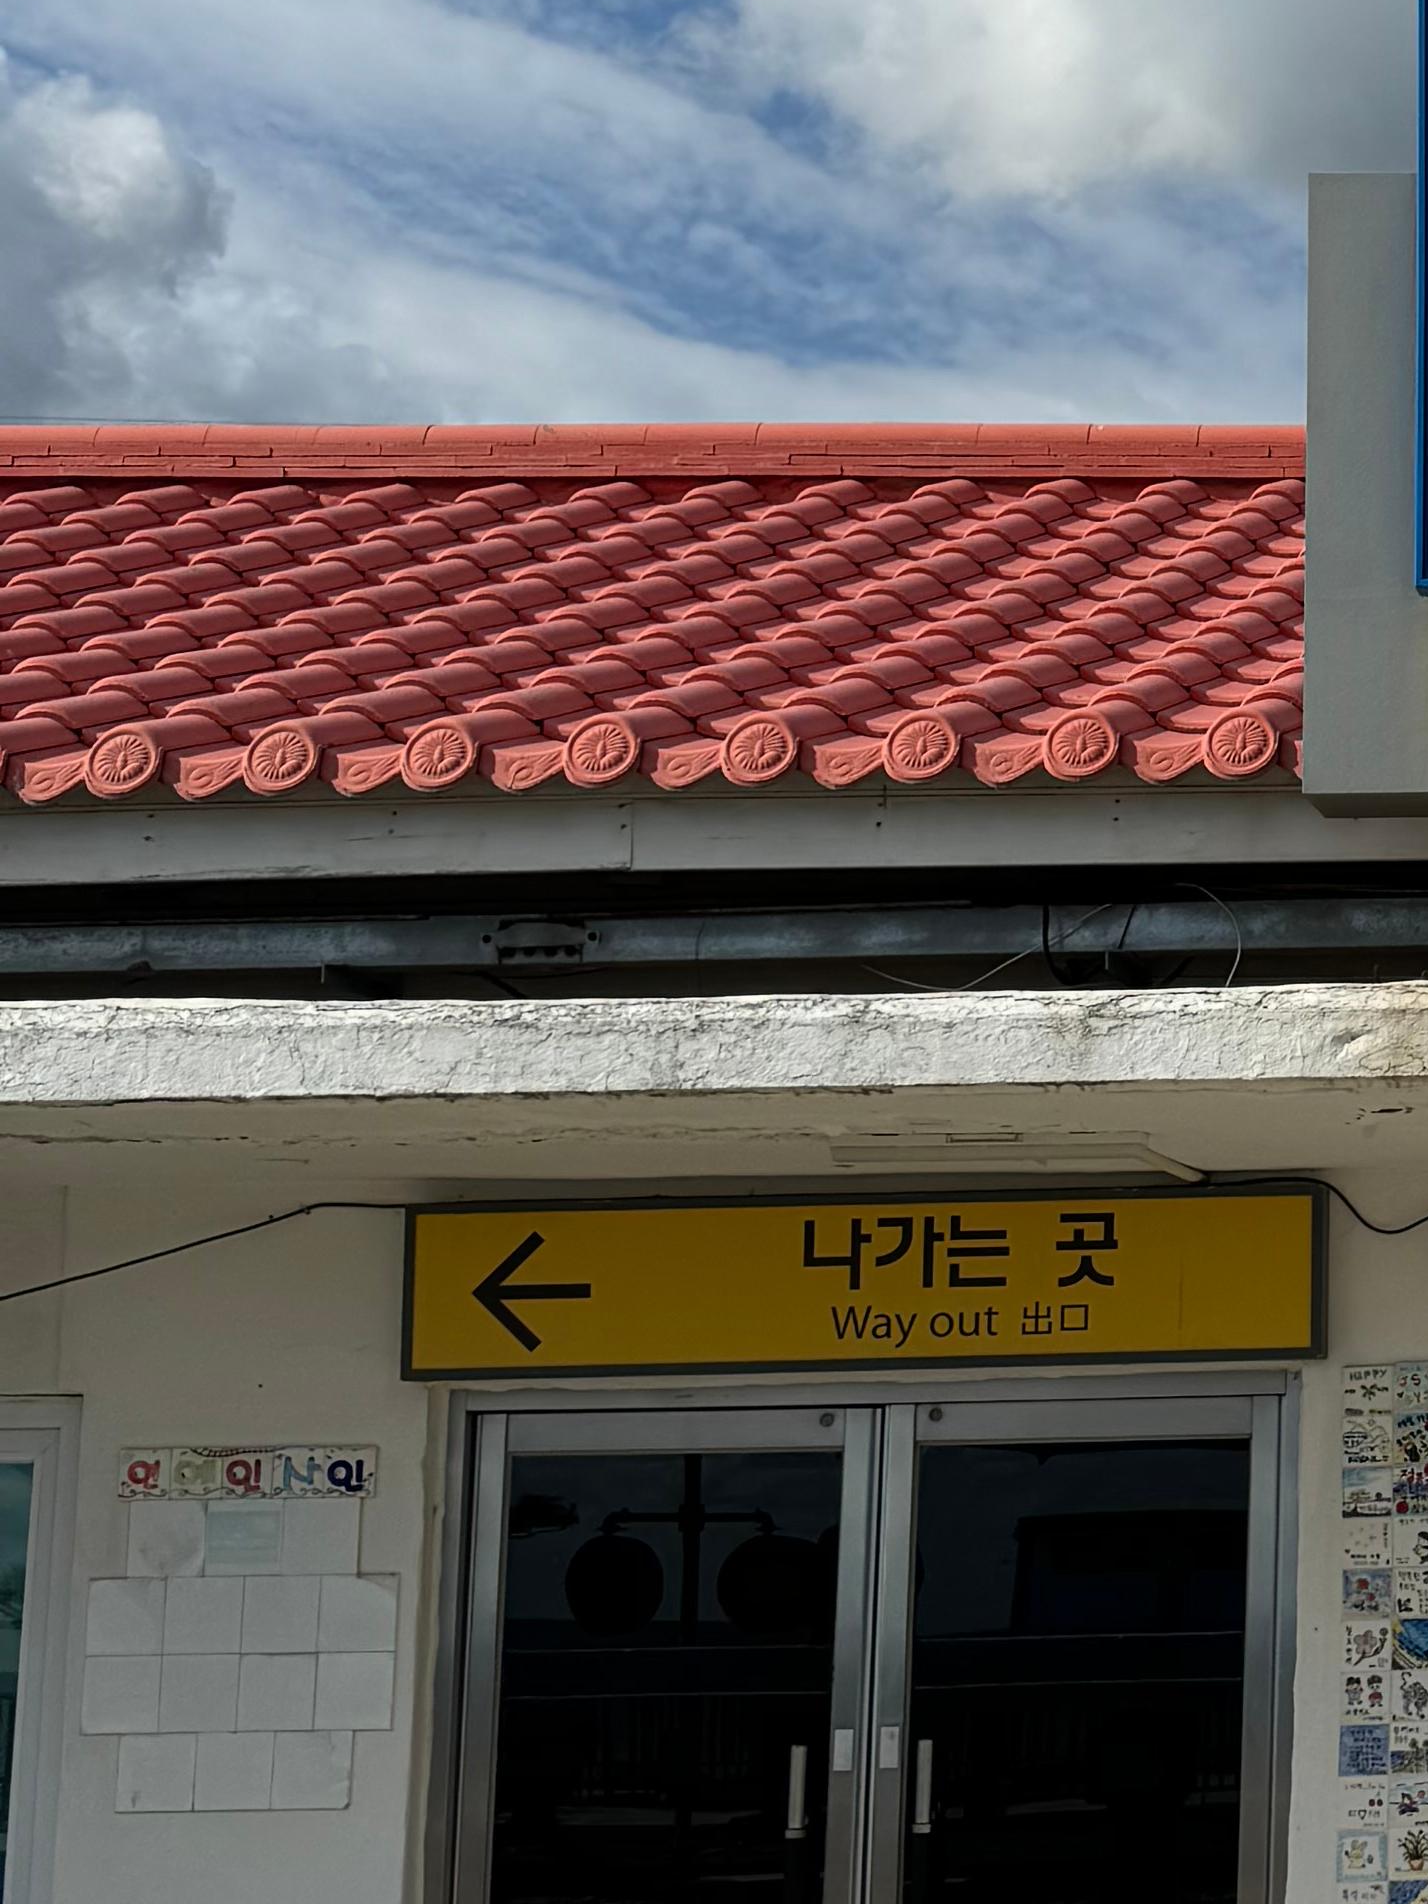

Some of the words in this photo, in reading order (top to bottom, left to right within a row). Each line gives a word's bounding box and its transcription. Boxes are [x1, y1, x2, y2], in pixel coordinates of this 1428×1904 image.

[803, 1214, 1011, 1291] 나가는
[1055, 1211, 1120, 1288] 곳
[832, 1304, 916, 1349] Way
[929, 1306, 999, 1340] out
[1021, 1301, 1089, 1336] 出口
